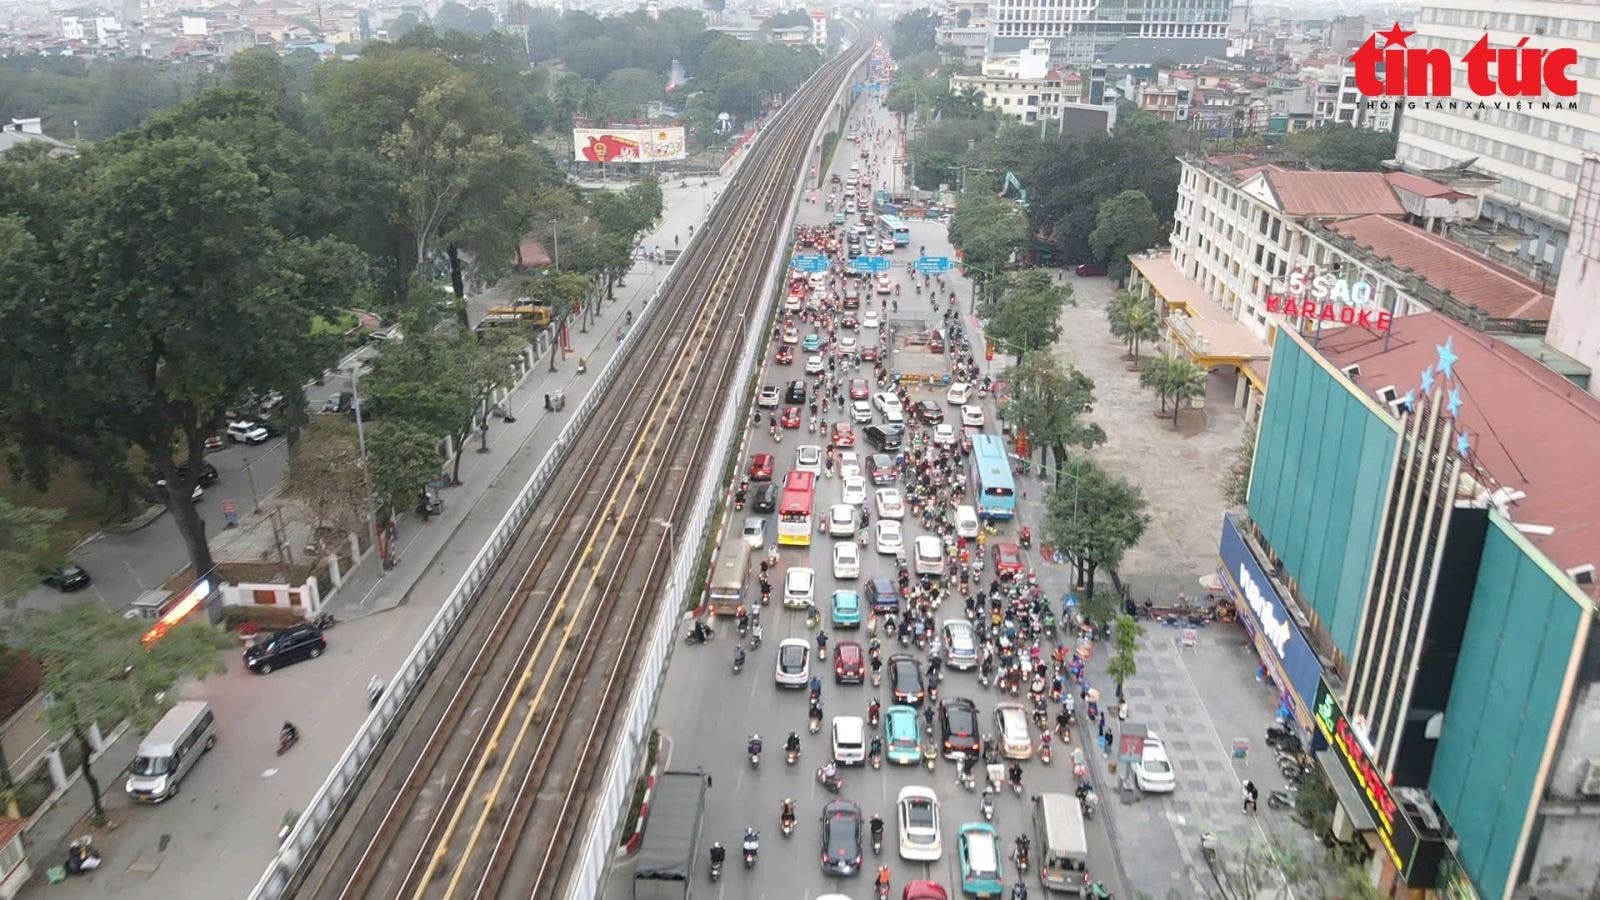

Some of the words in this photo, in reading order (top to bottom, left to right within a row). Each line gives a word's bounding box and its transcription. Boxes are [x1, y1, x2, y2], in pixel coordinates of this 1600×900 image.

[1290, 272, 1305, 294] 5
[1311, 276, 1371, 304] SAO
[1266, 293, 1392, 332] KARAOKE
